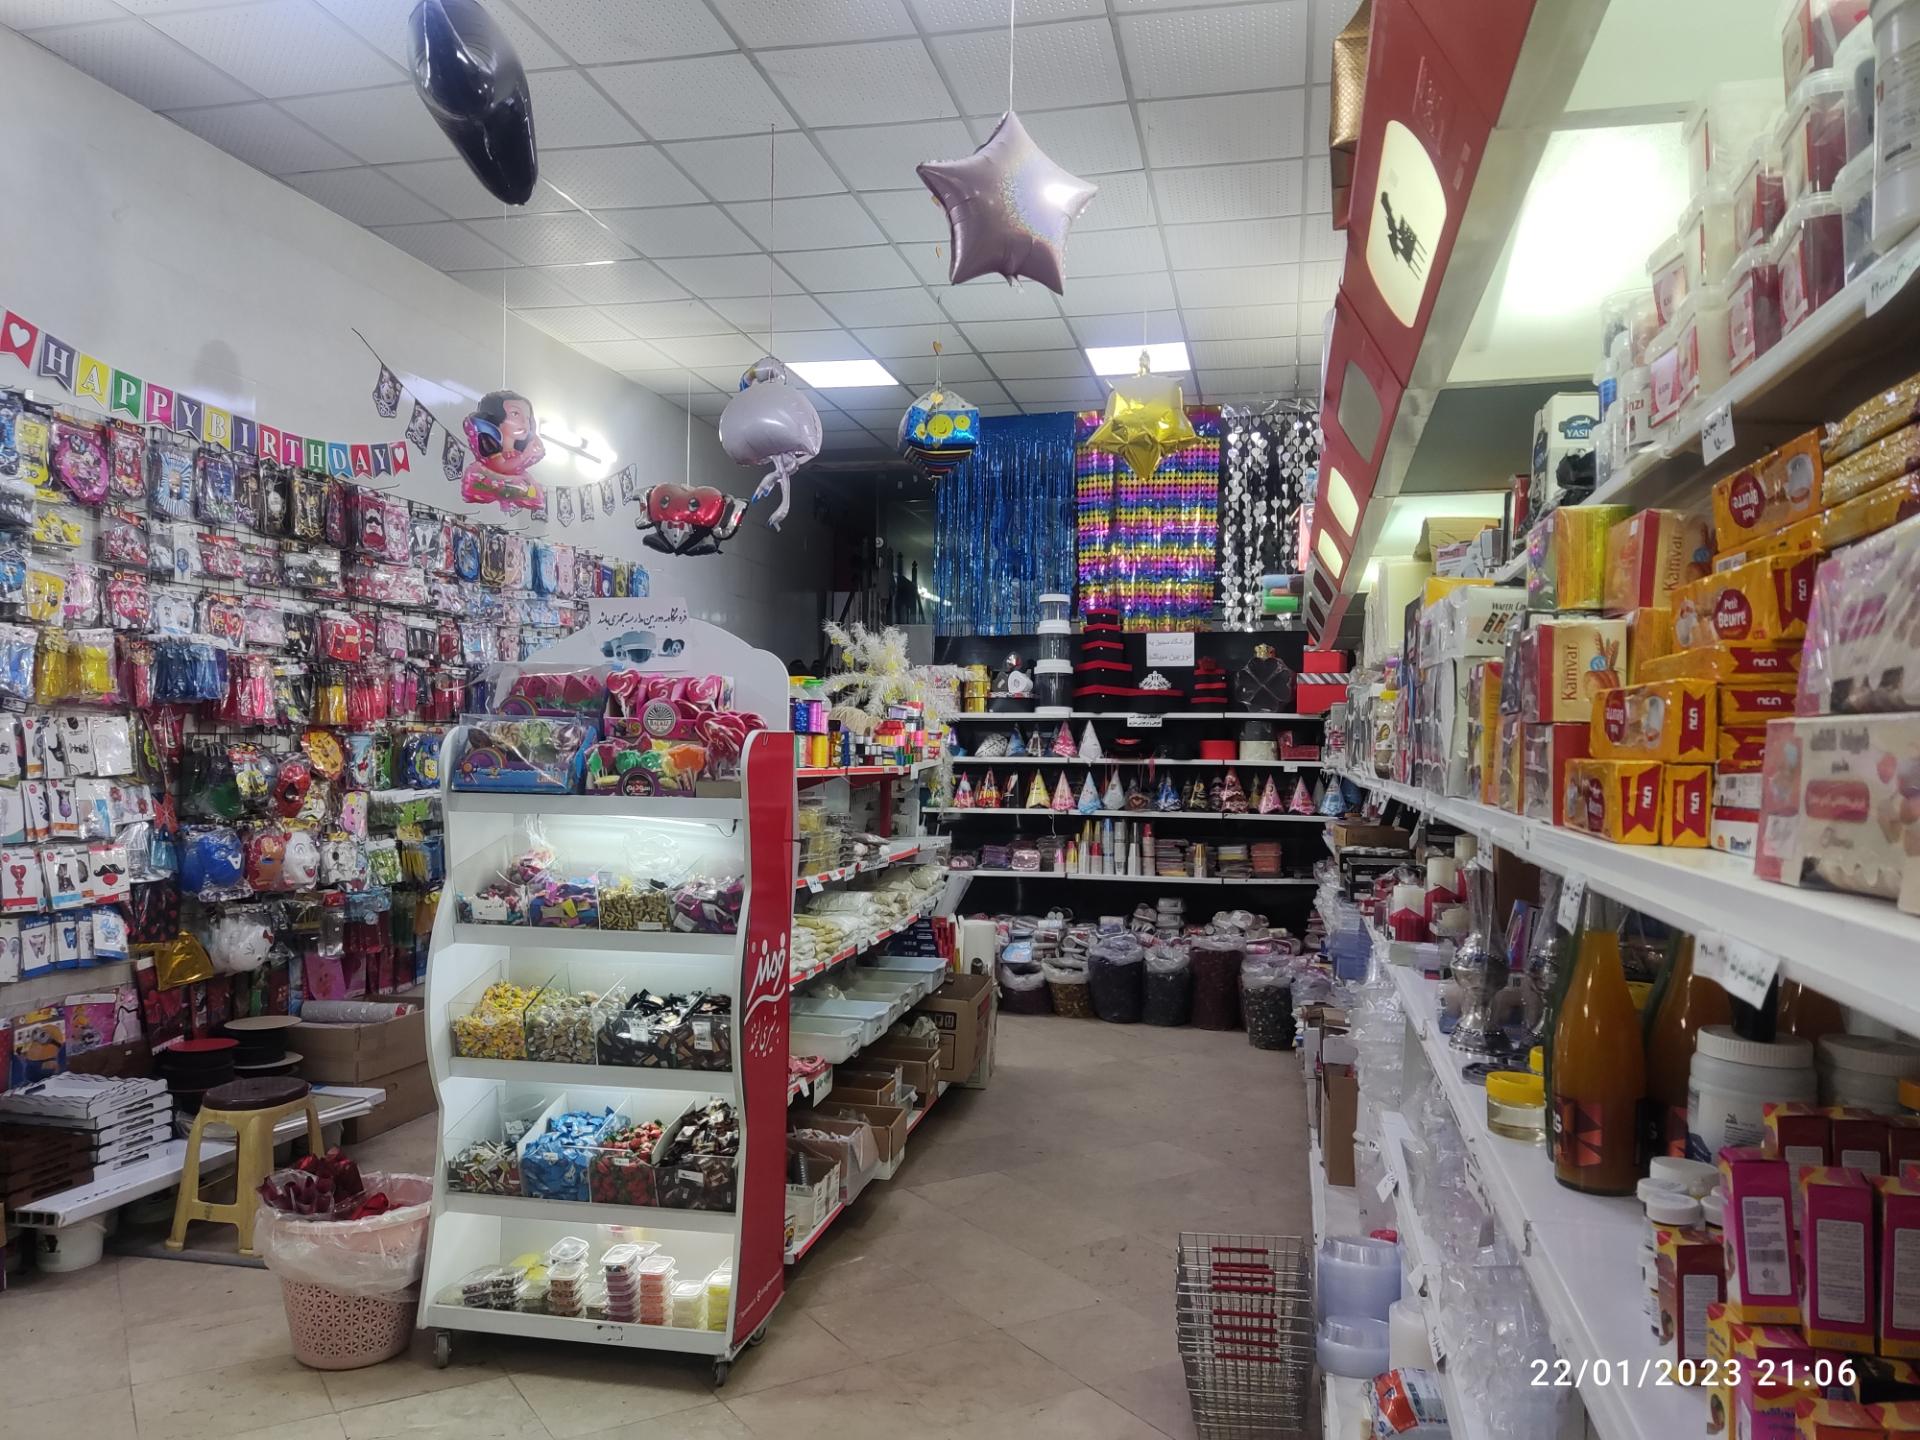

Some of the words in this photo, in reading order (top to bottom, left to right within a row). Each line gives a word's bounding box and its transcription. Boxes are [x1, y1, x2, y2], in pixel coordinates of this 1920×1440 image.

[46, 342, 199, 433] HAPPY
[208, 412, 390, 472] BIRTHDAY
[1561, 645, 1578, 701] Kamvar
